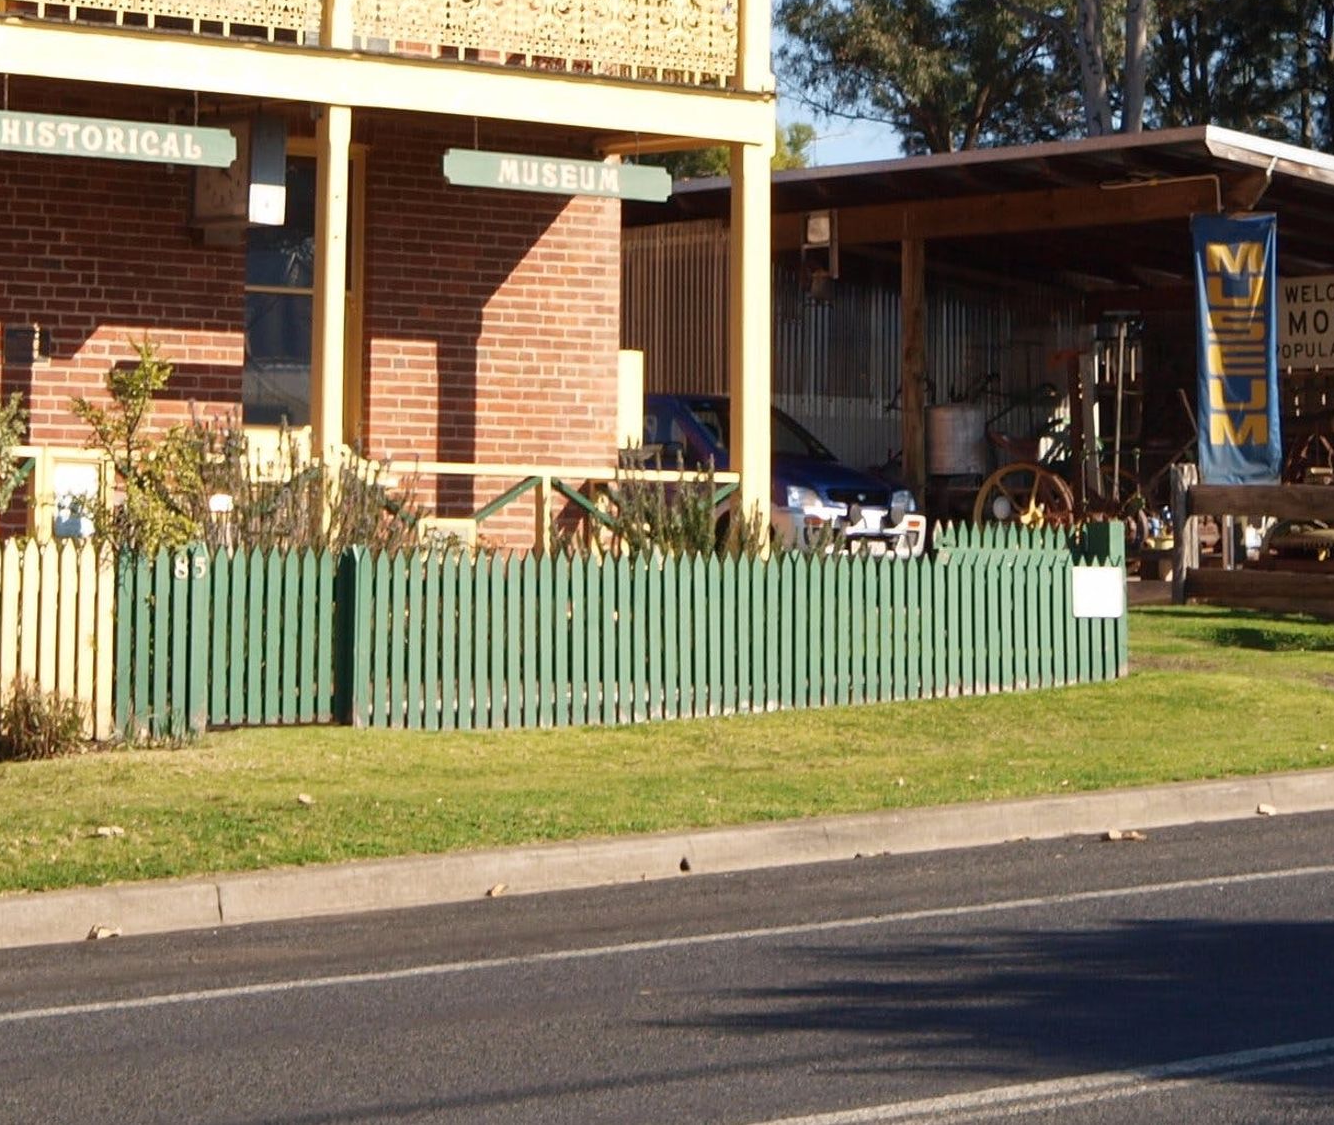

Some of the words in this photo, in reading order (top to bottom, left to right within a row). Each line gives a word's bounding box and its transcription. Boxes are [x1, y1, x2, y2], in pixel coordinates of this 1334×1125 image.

[0, 117, 203, 160] HISTORICAL
[498, 158, 620, 193] MUSEUM
[1205, 241, 1268, 446] MUSEUM
[173, 555, 207, 580] 85
